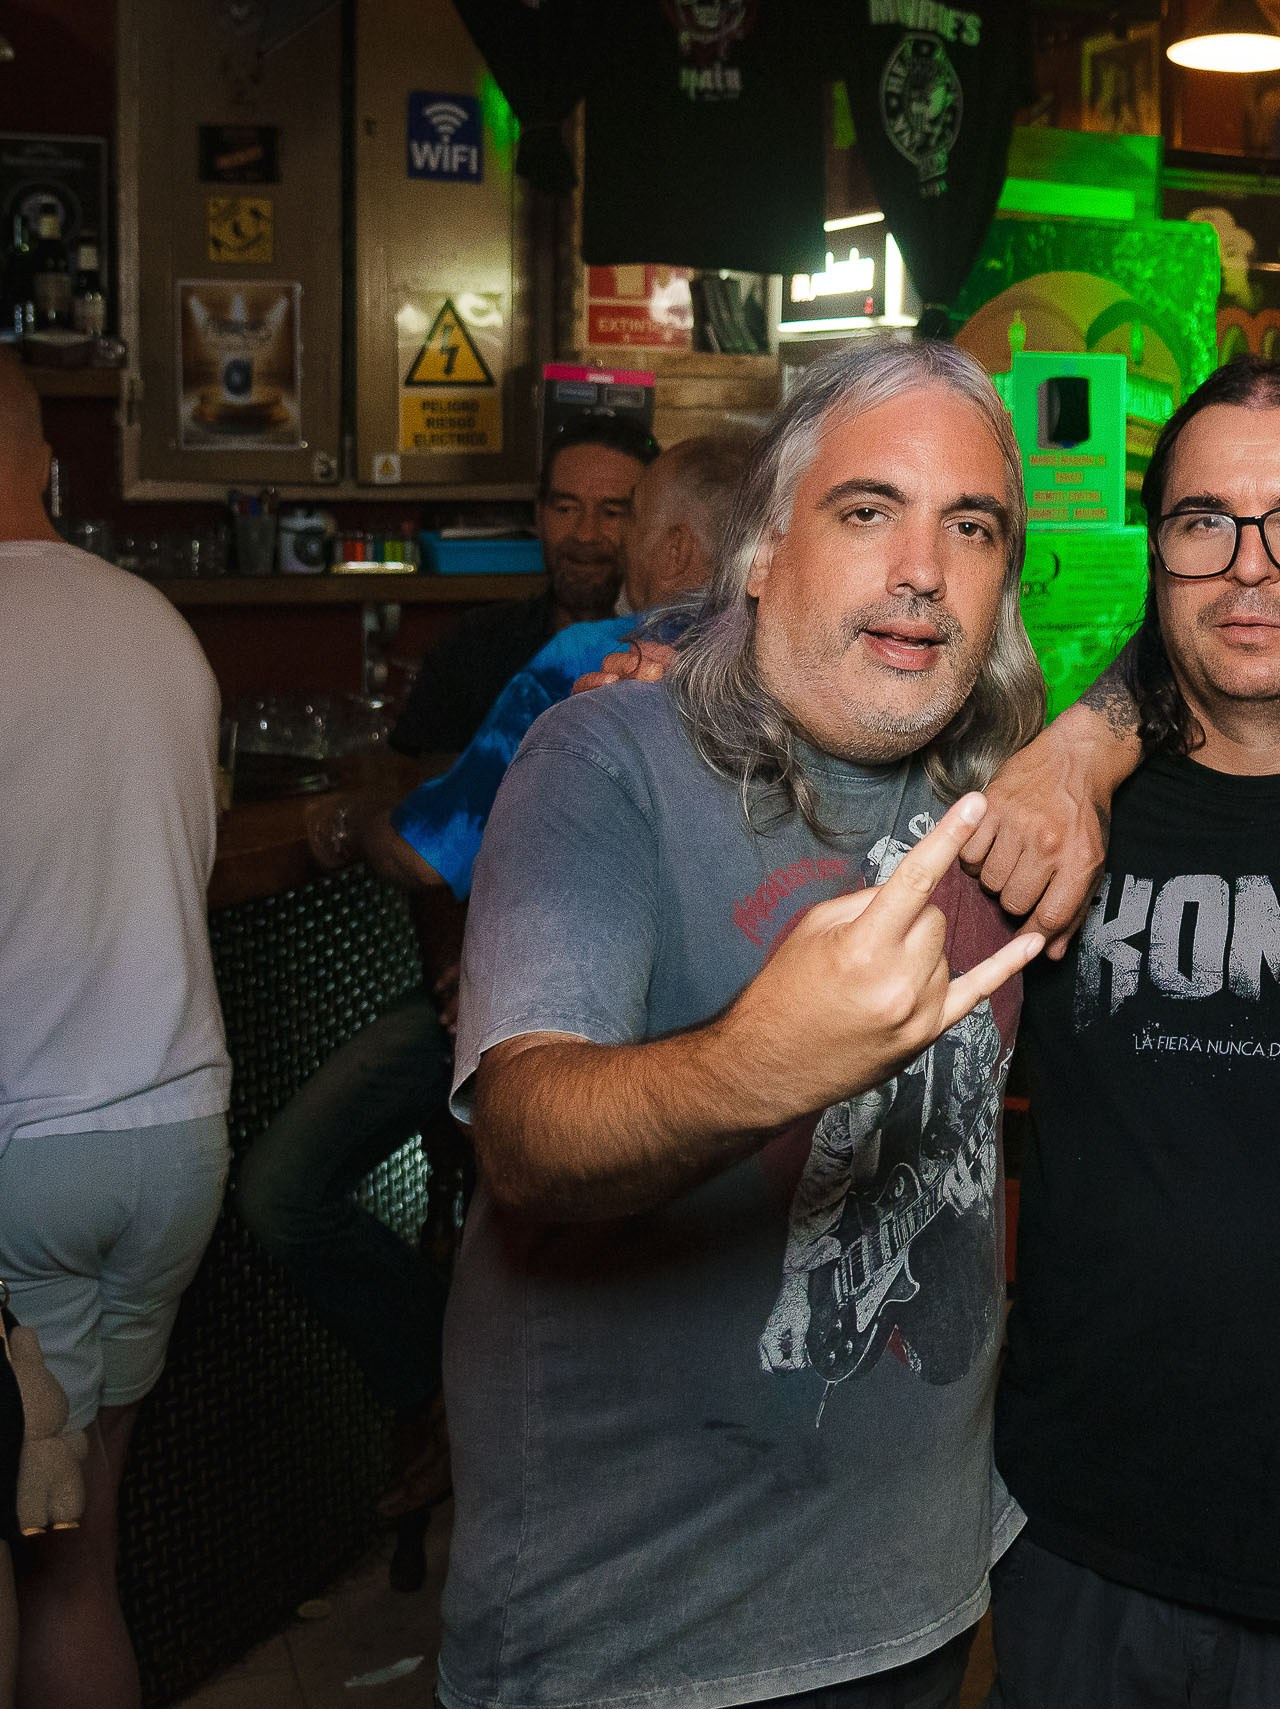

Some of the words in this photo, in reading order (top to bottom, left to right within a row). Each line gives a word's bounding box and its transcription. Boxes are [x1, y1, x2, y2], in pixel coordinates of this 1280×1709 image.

[410, 140, 478, 174] WIFI
[1134, 1035, 1154, 1051] LA
[1157, 1036, 1203, 1052] FIERA
[1206, 1040, 1266, 1057] NUNCA
